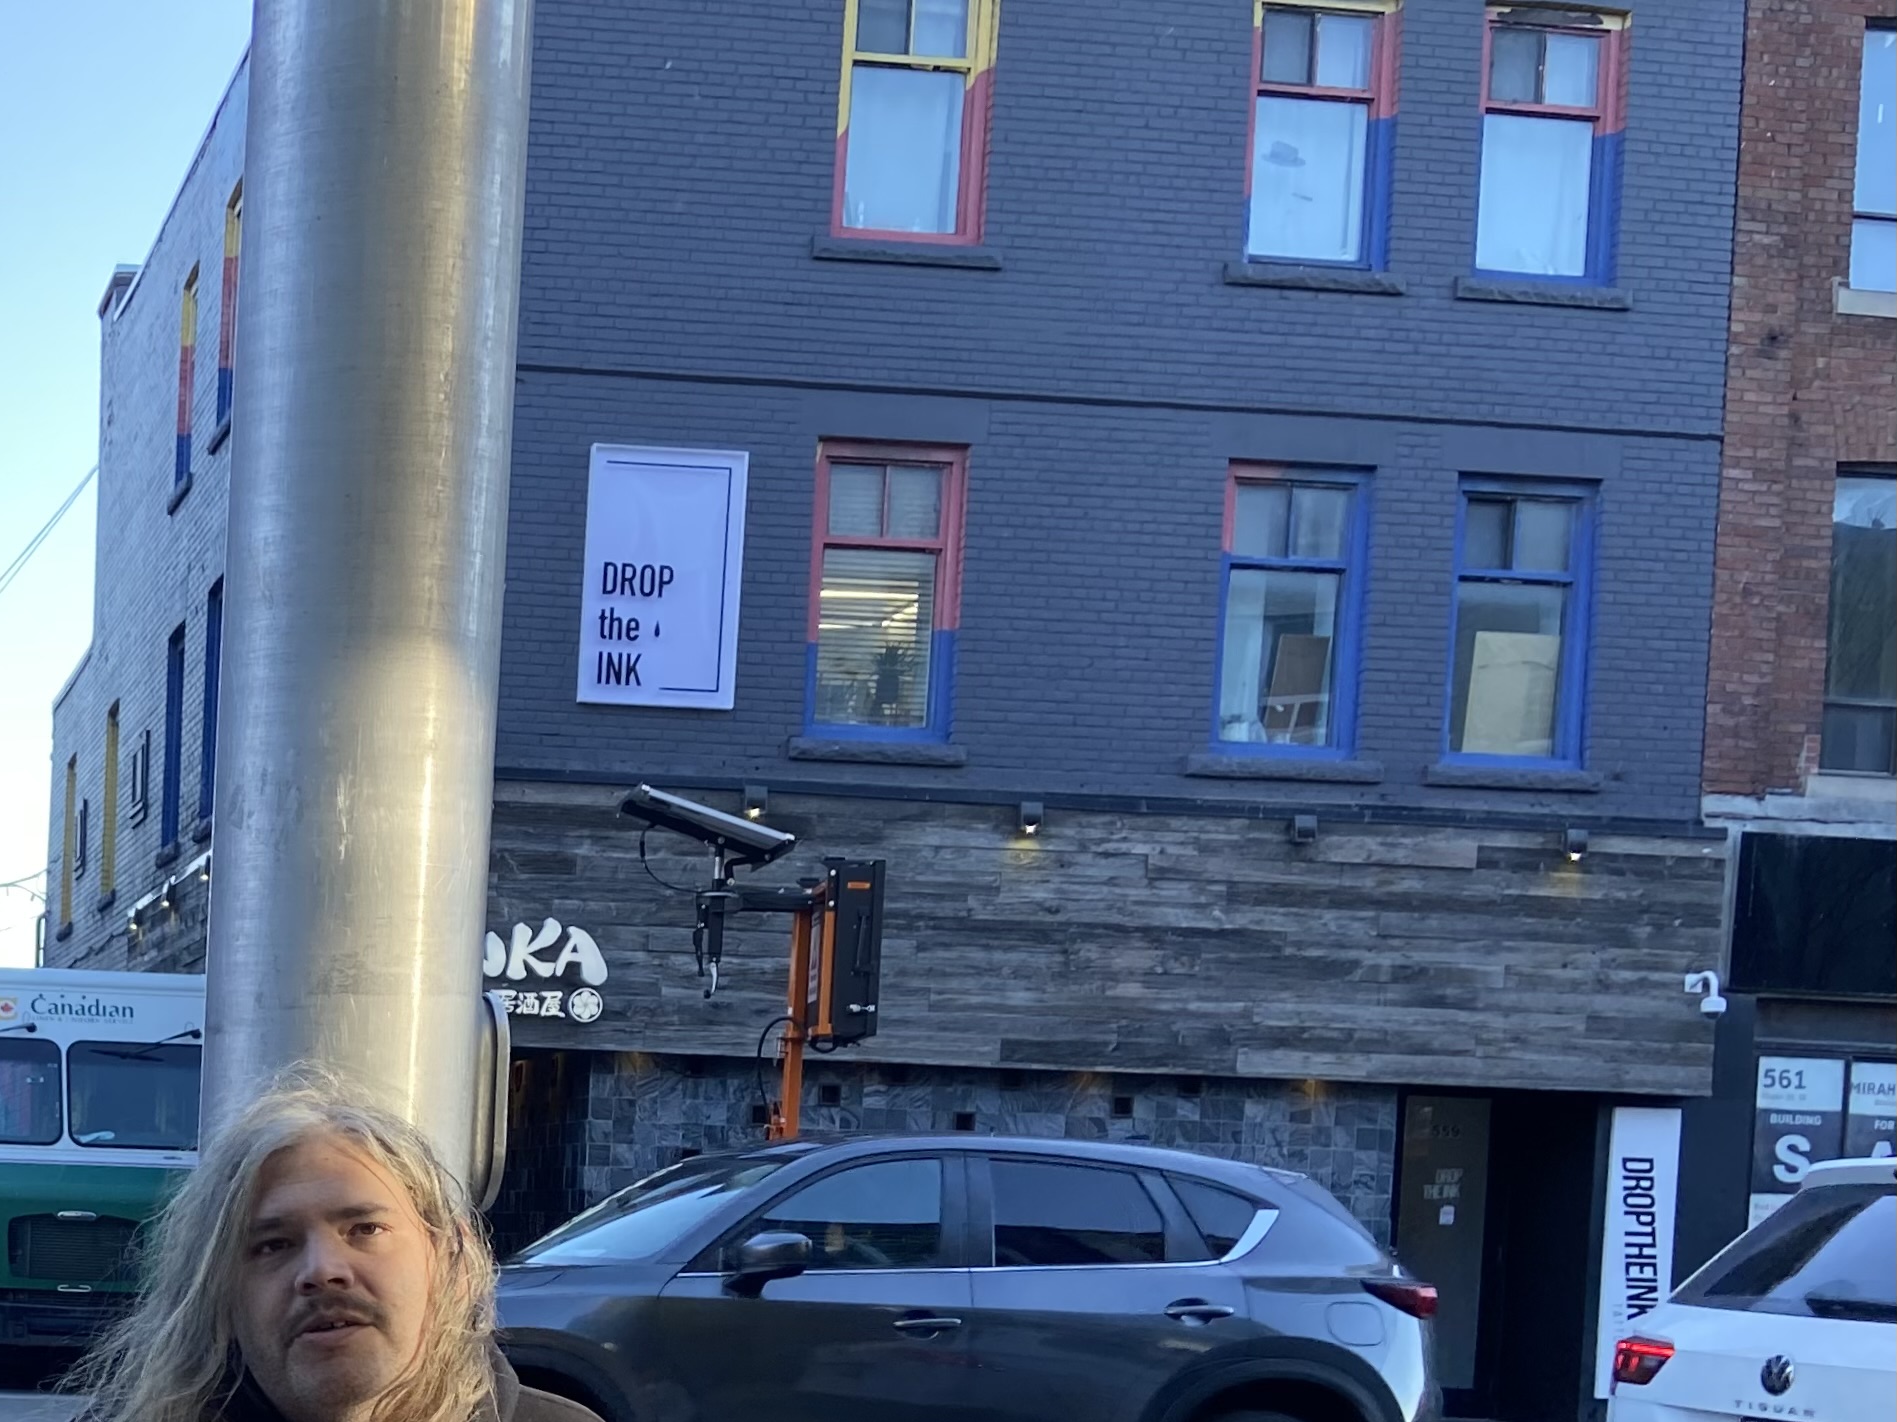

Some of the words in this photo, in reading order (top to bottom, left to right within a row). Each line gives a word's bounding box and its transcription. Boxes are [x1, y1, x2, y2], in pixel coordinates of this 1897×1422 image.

[602, 562, 674, 598] DROP
[598, 607, 640, 641] the
[597, 651, 642, 686] INK
[31, 994, 134, 1018] Canadian
[1763, 1068, 1806, 1090] 561
[1770, 1113, 1822, 1126] BUILDING
